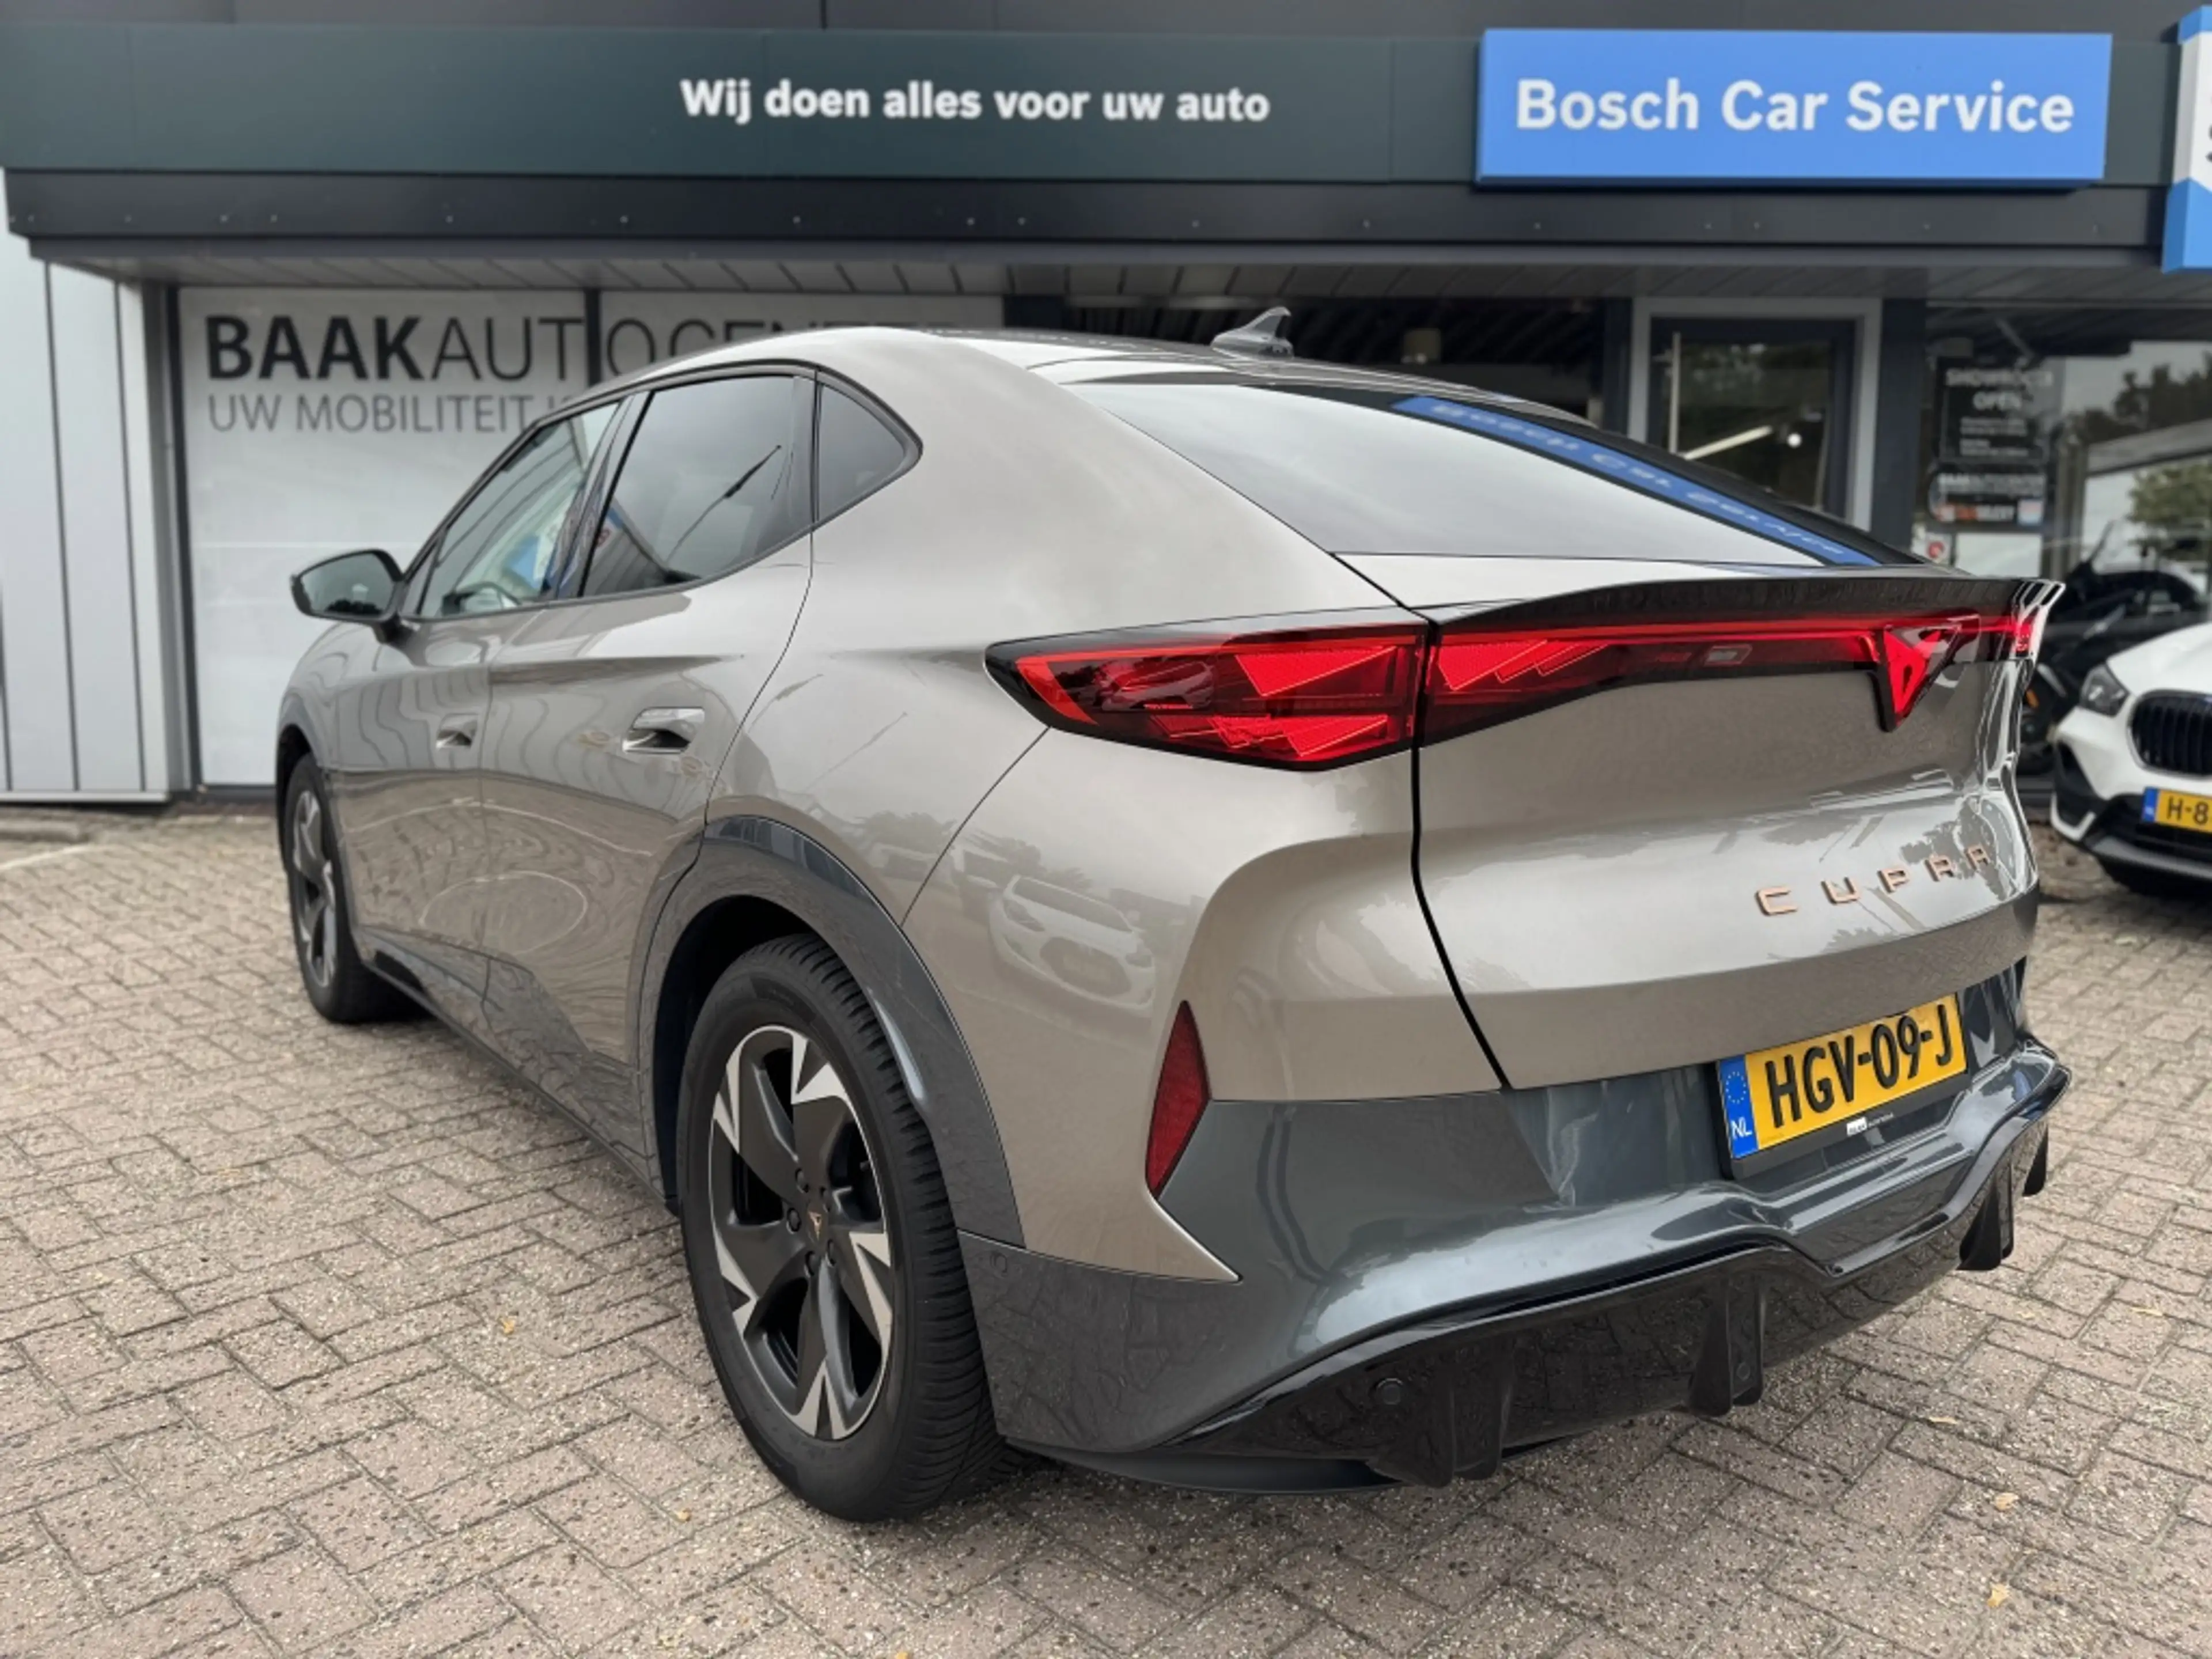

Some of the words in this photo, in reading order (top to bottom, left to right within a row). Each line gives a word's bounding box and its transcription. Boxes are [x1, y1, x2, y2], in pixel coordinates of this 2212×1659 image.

[680, 78, 751, 124] Wij
[764, 78, 870, 117] doen
[883, 80, 982, 118] alles
[994, 91, 1090, 119] voor
[1103, 92, 1164, 120] uw
[1176, 88, 1270, 121] auto
[1517, 77, 1699, 130] Bosch
[1721, 80, 1828, 130] Car
[1846, 80, 2074, 132] Service
[208, 395, 278, 431] UW
[293, 393, 533, 431] MOBILITEIT
[1755, 844, 1991, 916] CUPRA
[1764, 1003, 1952, 1129] HGV-09-J
[1730, 1116, 1753, 1139] NL
